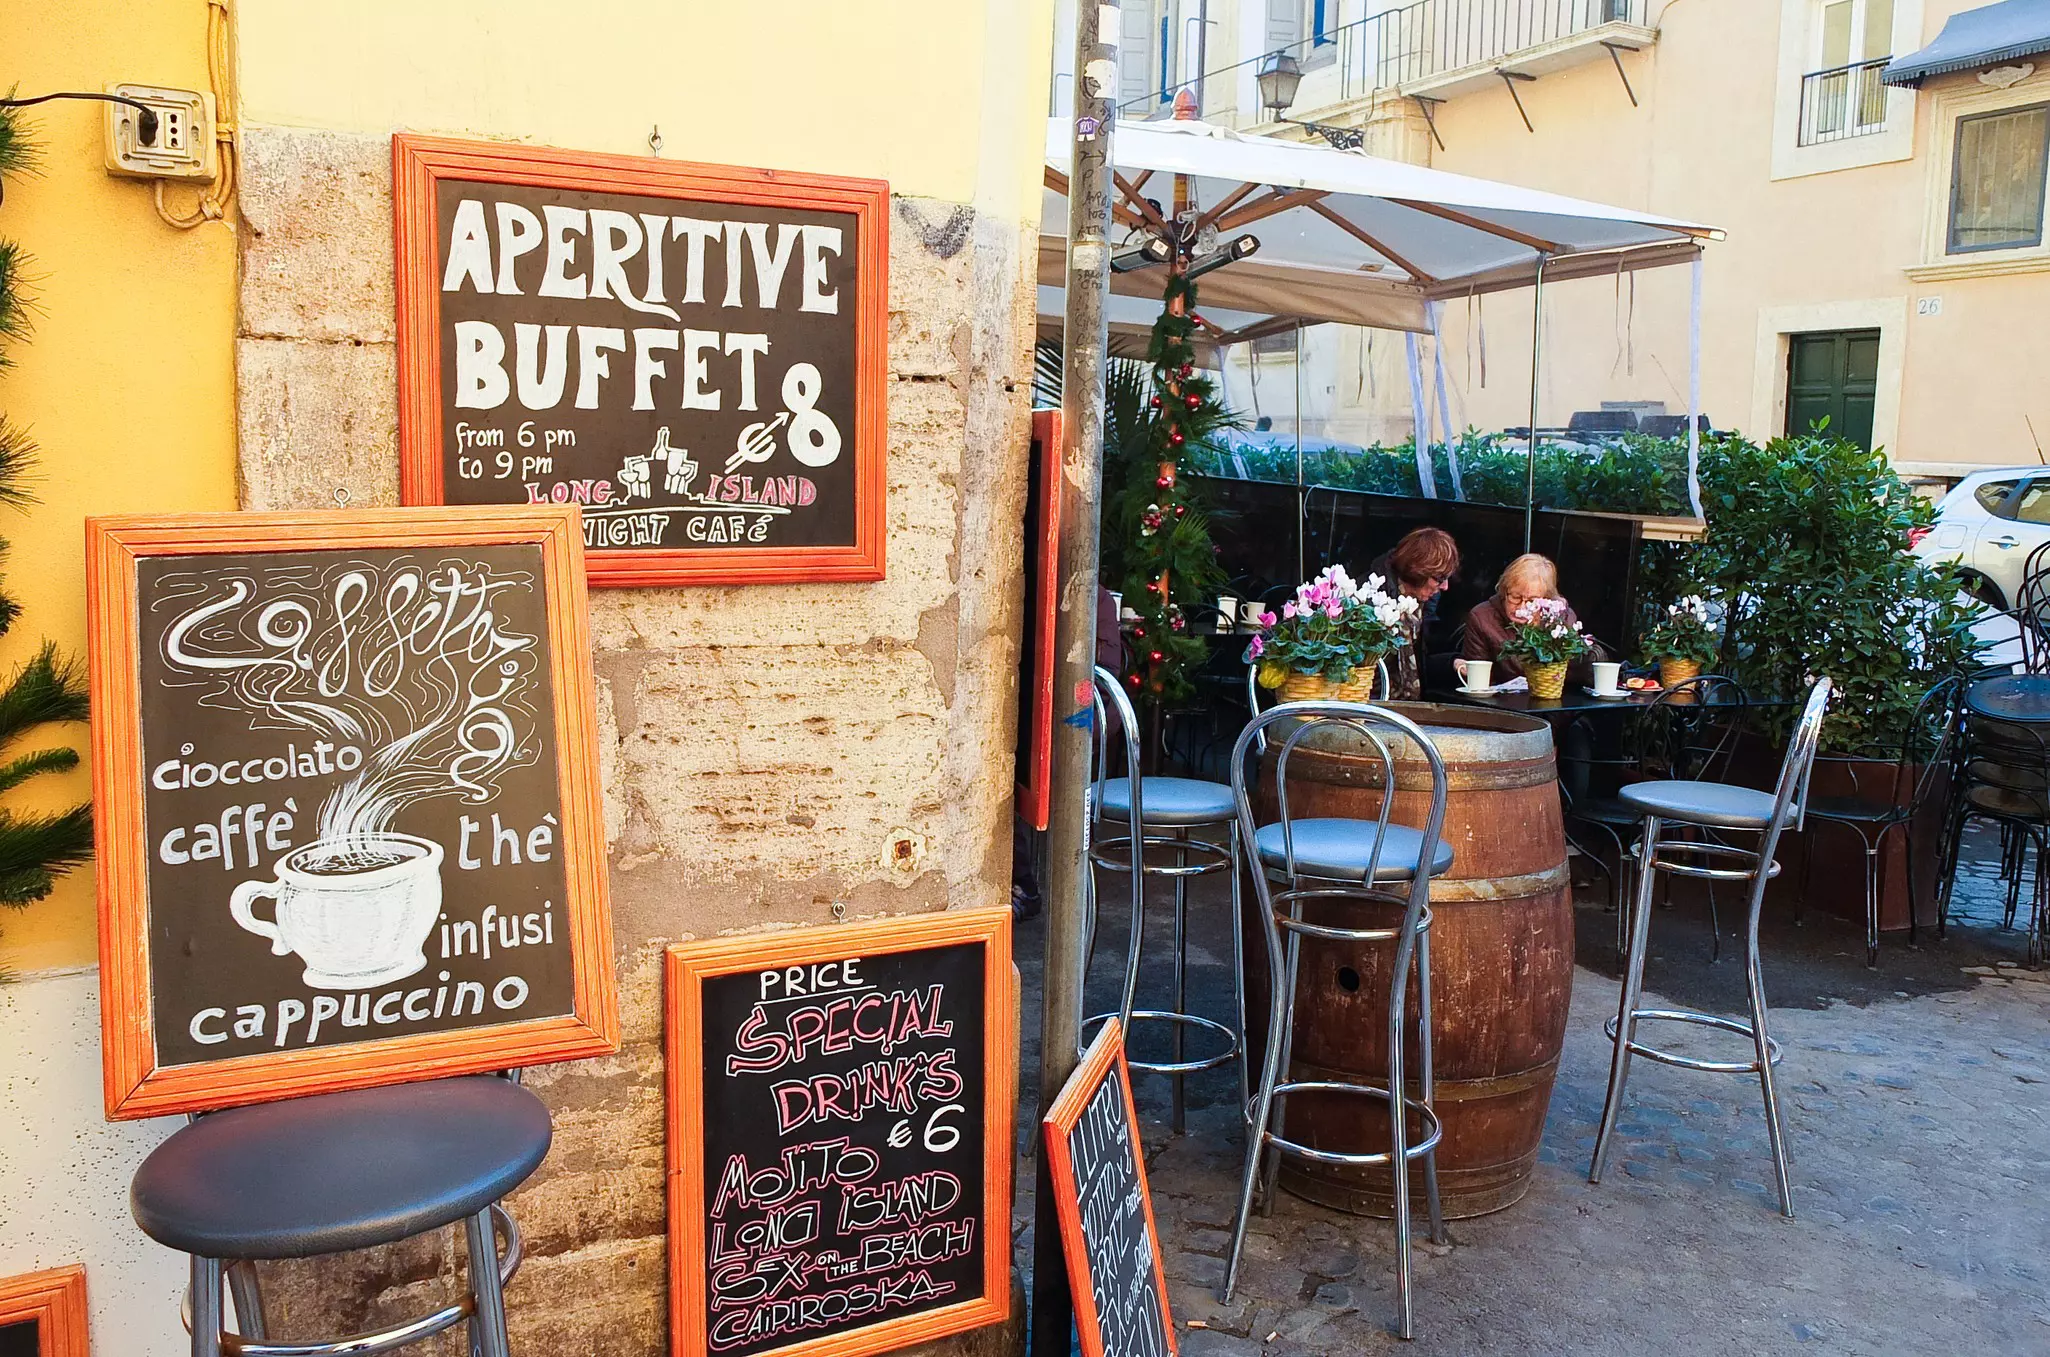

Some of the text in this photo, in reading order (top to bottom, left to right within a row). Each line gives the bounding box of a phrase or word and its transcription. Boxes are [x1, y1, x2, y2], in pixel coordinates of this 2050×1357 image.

[442, 199, 844, 322] APERITIVE
[1919, 298, 1941, 315] 26
[455, 320, 771, 411] BUFFET
[456, 421, 576, 459] from 6 pm
[781, 363, 842, 467] 8
[458, 451, 553, 488] to 9 pm
[524, 473, 818, 507] LONG ISLAND
[152, 739, 364, 792] cioccolato
[159, 796, 299, 871] caffè
[457, 811, 558, 871] thè
[439, 899, 554, 961] infusi
[189, 970, 530, 1047] cappuccino
[760, 958, 865, 1001] PRICE
[726, 984, 958, 1077] SPECIAL
[887, 1104, 966, 1153] € 6
[1078, 1069, 1122, 1181] LITRO
[710, 1170, 961, 1268] LONG ISLAND
[711, 1217, 975, 1311] SEX ON THE BEACH
[1091, 1200, 1129, 1323] SPRITZ
